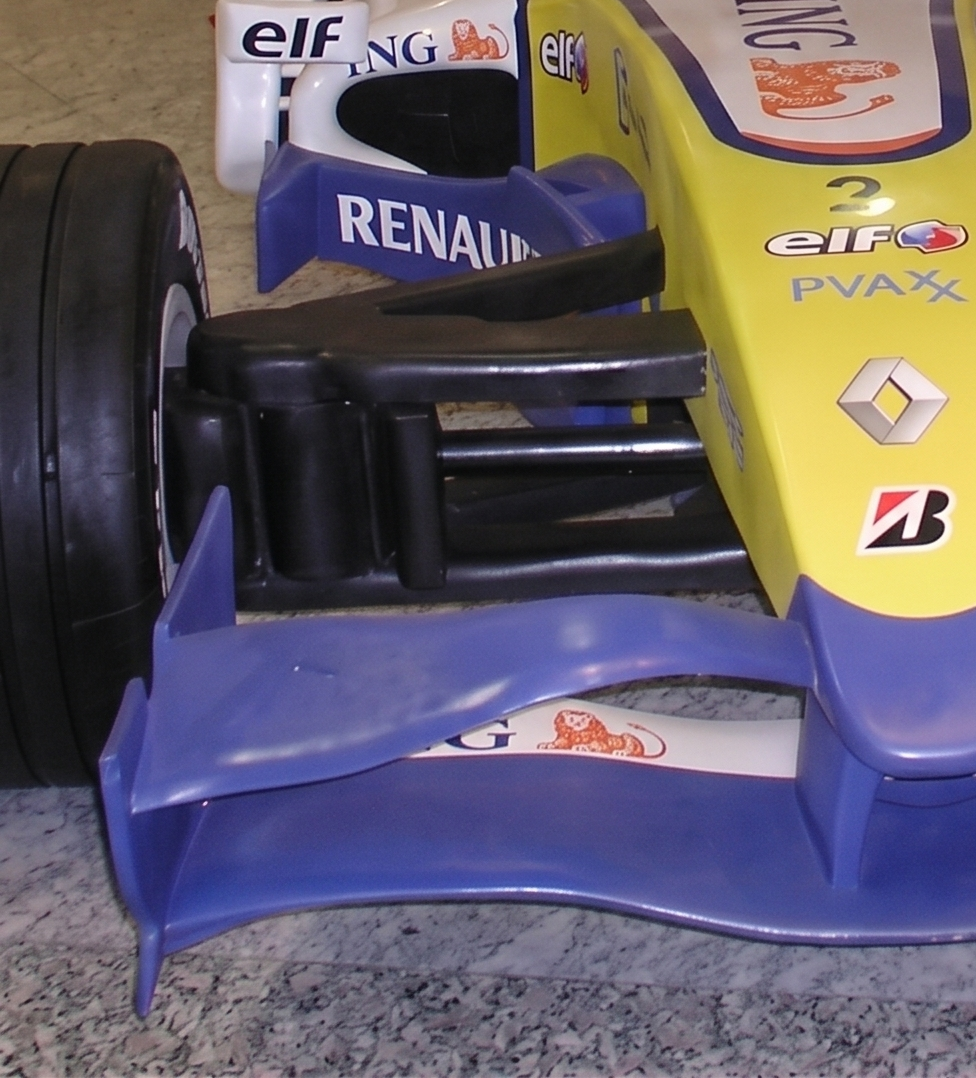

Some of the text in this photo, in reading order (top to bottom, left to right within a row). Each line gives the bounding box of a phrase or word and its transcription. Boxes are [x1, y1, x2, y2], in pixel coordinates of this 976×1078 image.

[242, 16, 343, 58] elf
[540, 30, 576, 82] elf
[826, 175, 884, 213] 2
[765, 224, 894, 257] elf
[791, 269, 969, 303] PVAXX
